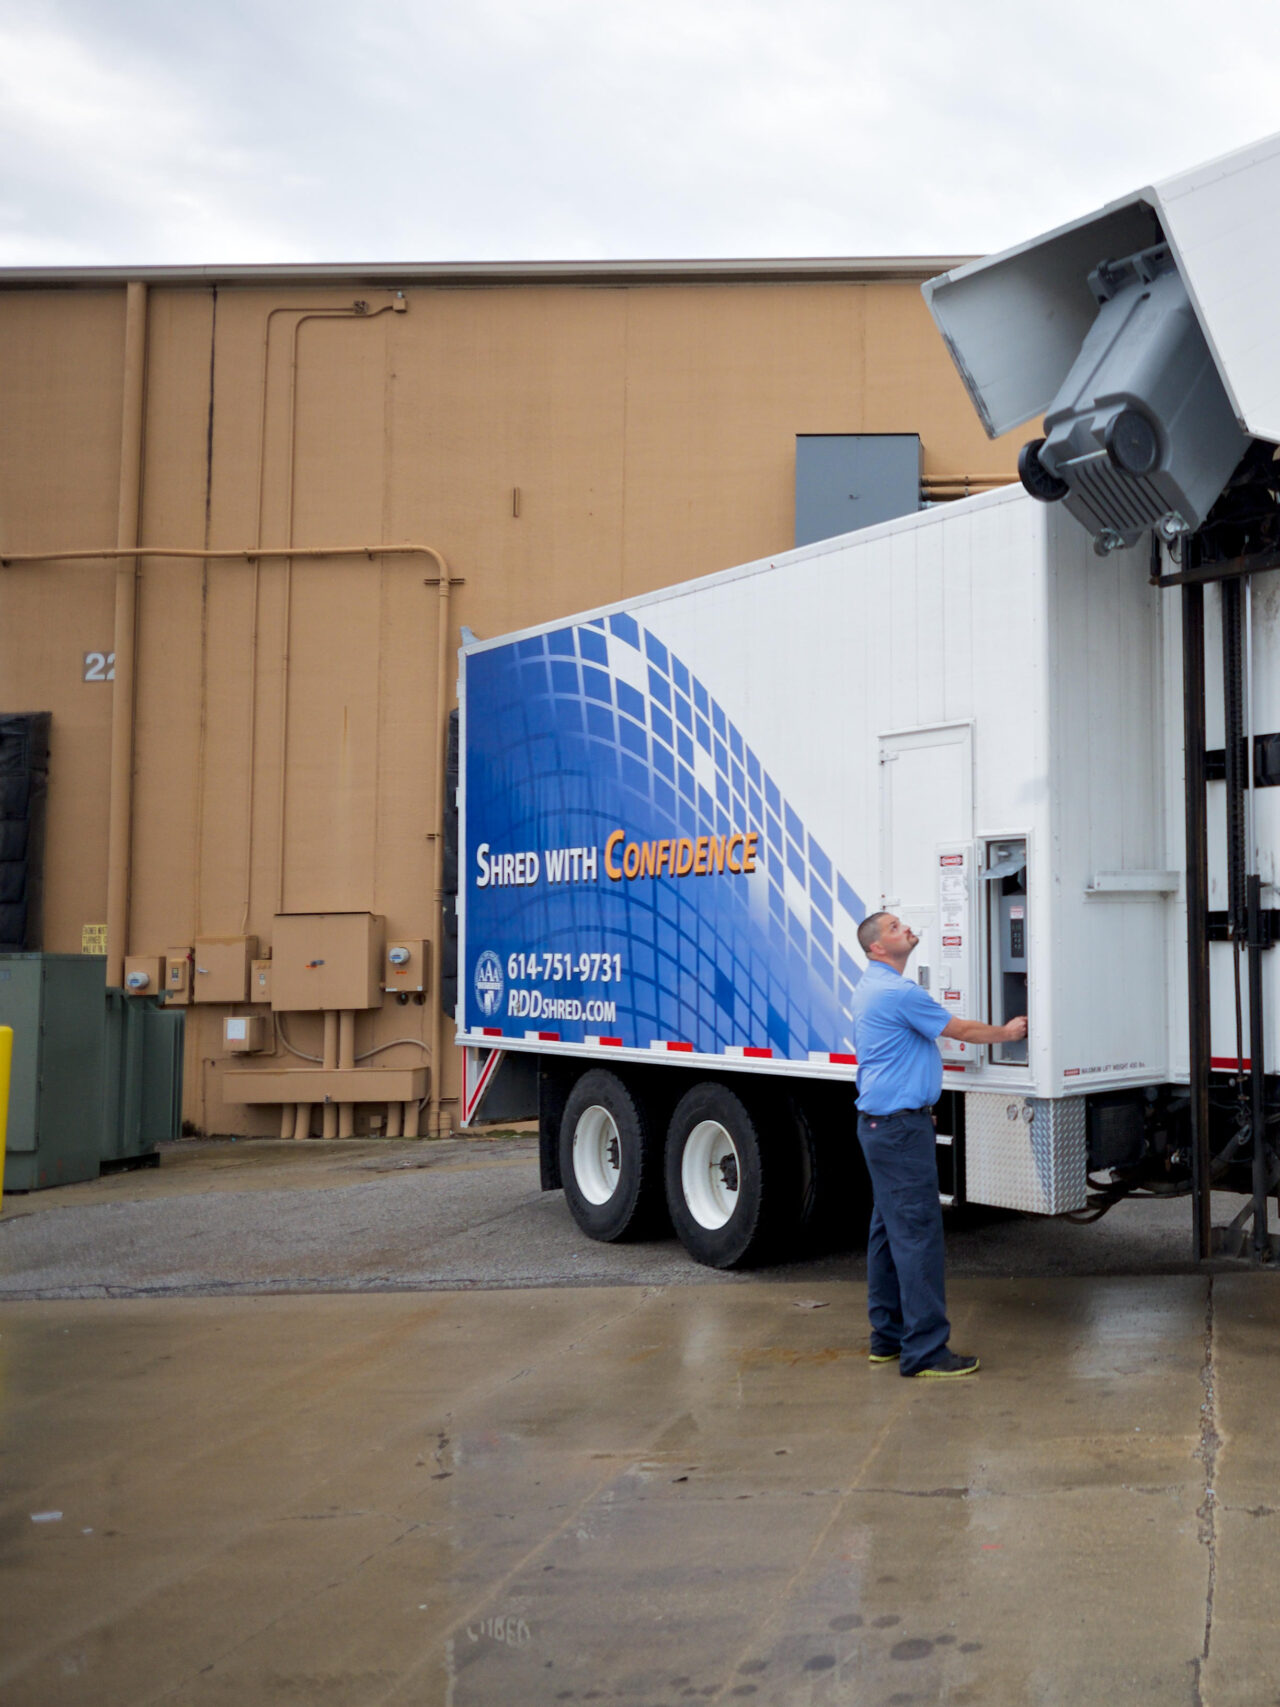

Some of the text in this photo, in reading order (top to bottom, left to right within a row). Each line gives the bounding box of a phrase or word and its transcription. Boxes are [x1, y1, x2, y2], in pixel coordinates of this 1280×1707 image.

[476, 829, 758, 887] SHRED WITH CONFIDENCE
[507, 952, 622, 983] 614-751-9731
